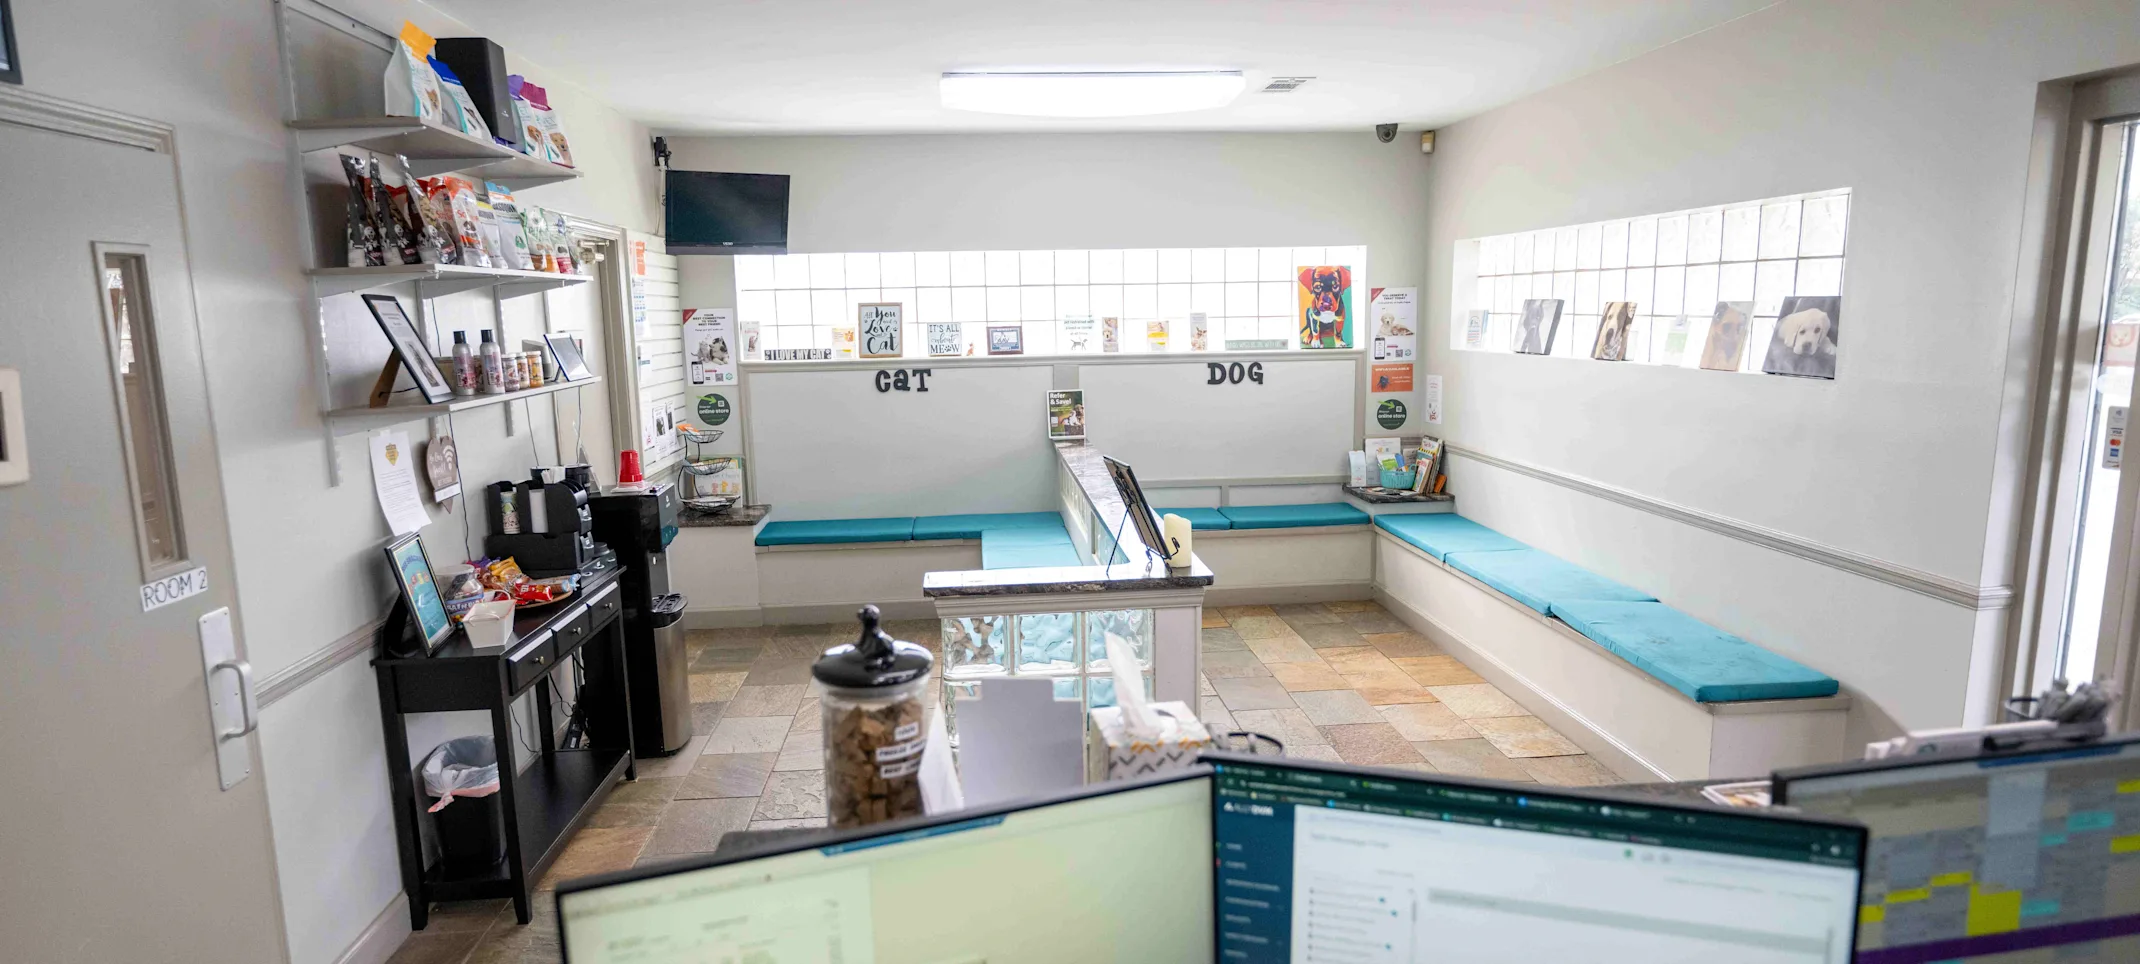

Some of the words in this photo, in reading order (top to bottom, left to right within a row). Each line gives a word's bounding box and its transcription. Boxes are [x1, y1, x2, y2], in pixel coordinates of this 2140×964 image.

[875, 306, 896, 325] You
[946, 324, 960, 332] ALL
[867, 333, 899, 354] Cat
[776, 350, 796, 360] LOVE
[796, 349, 809, 360] MY
[810, 349, 825, 359] CAT
[1207, 361, 1264, 385] DOG
[143, 574, 193, 607] ROOM
[198, 570, 207, 590] 2
